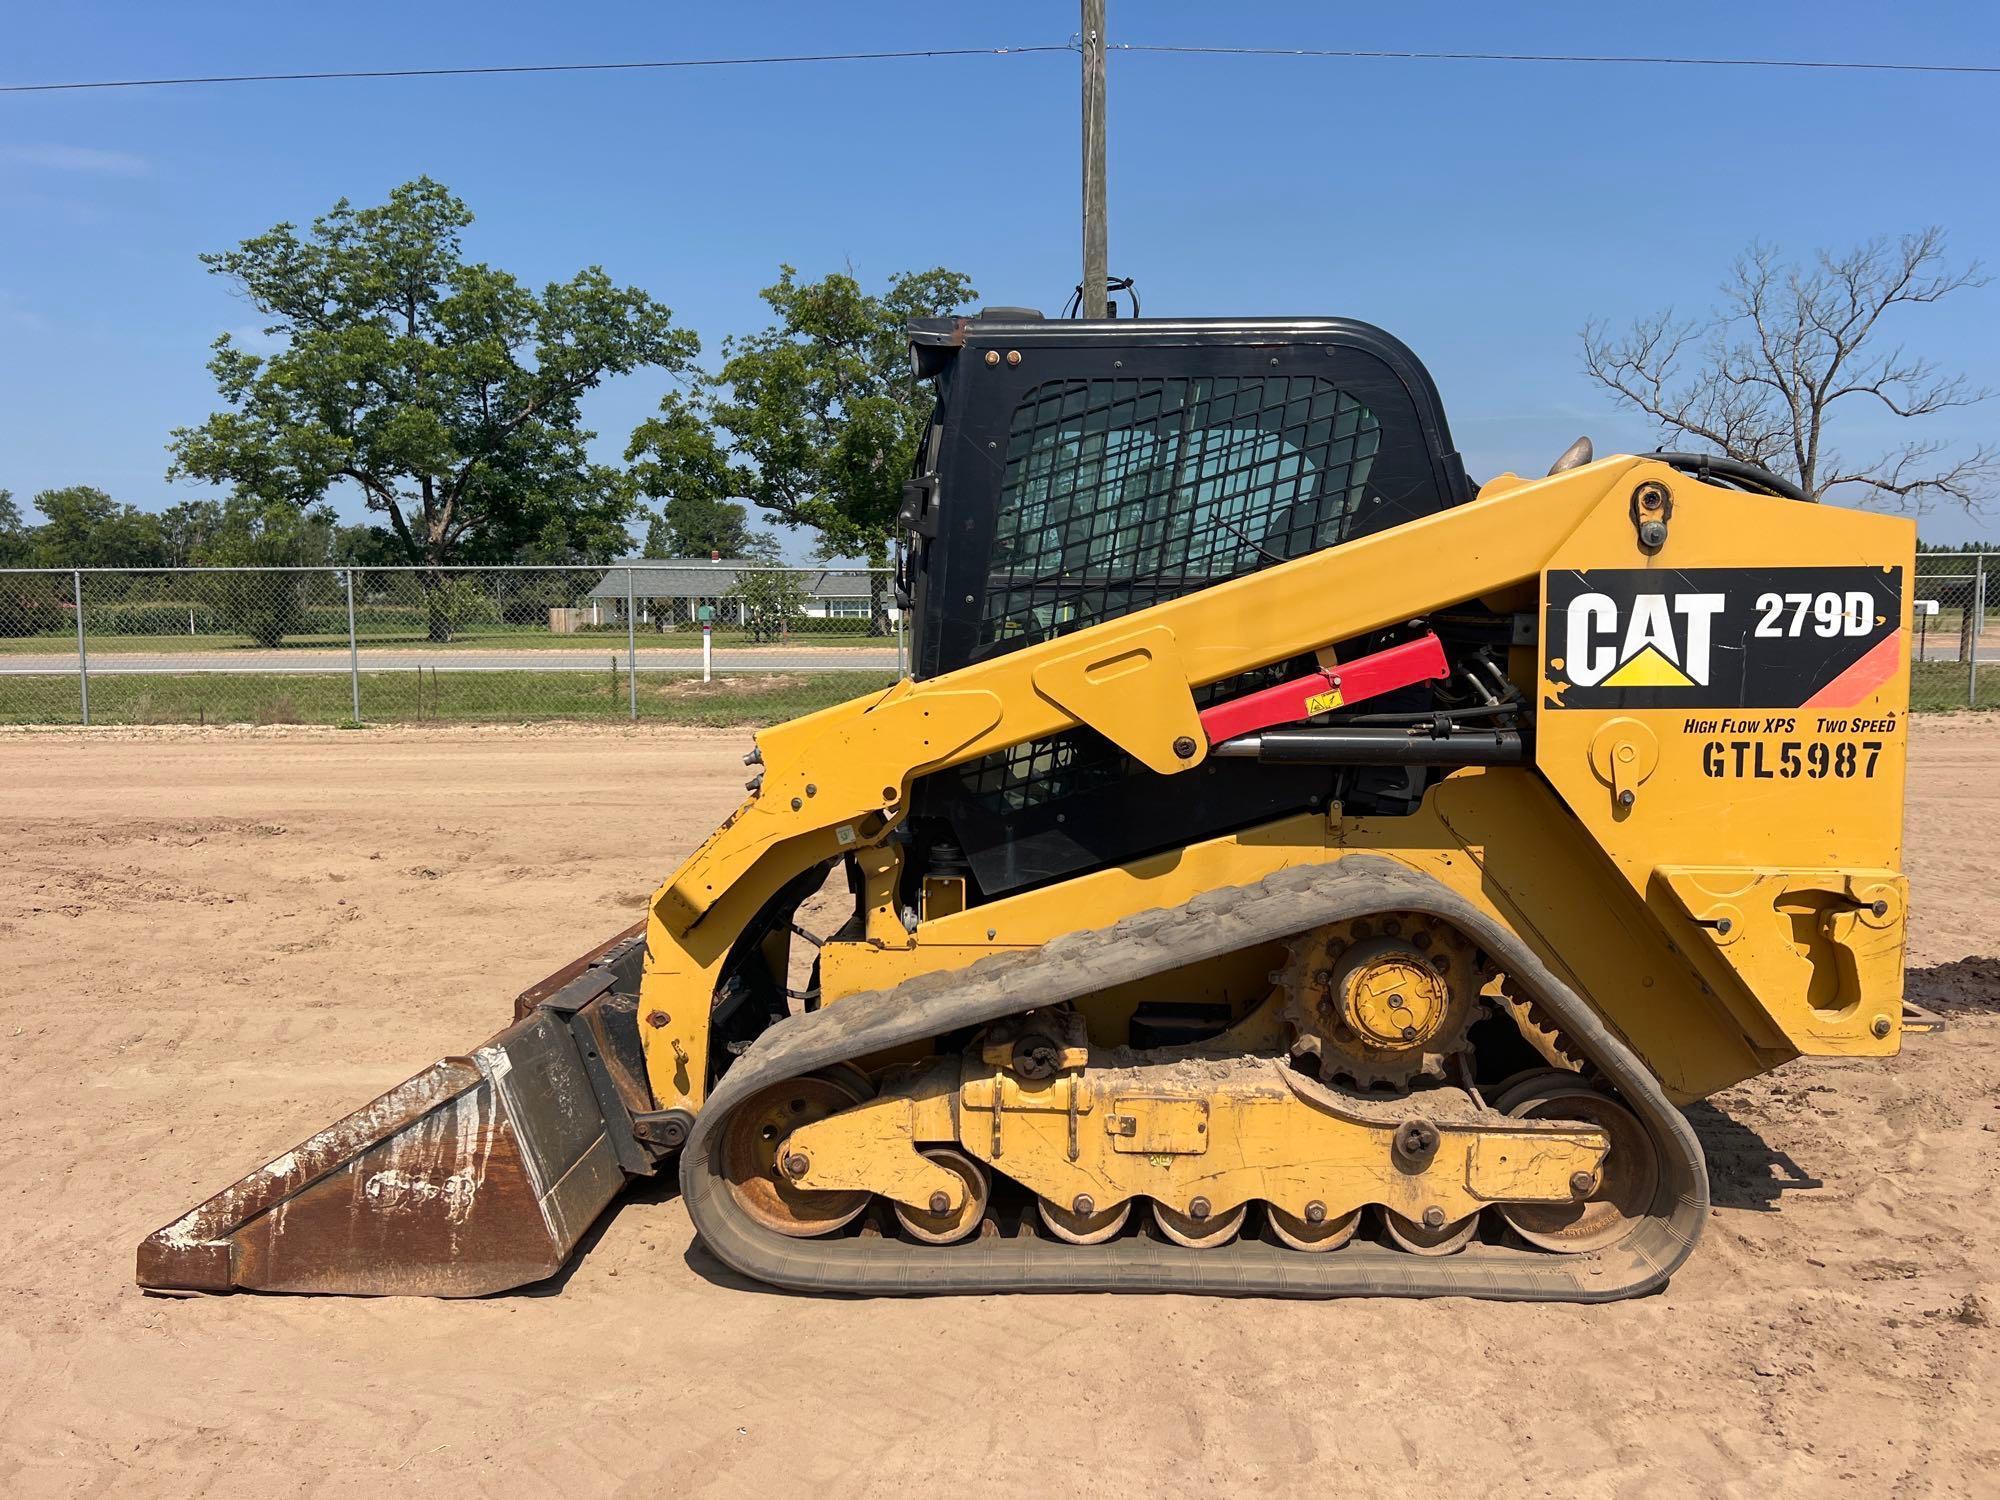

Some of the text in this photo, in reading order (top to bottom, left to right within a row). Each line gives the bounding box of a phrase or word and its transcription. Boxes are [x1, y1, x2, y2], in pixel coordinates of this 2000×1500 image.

[1754, 591, 1875, 638] 279D
[1566, 592, 1725, 687] CAT
[1683, 718, 1796, 734] HIGH FLOW XPS
[1816, 717, 1896, 733] TWO SPEED
[1702, 741, 1883, 779] GTL5987
